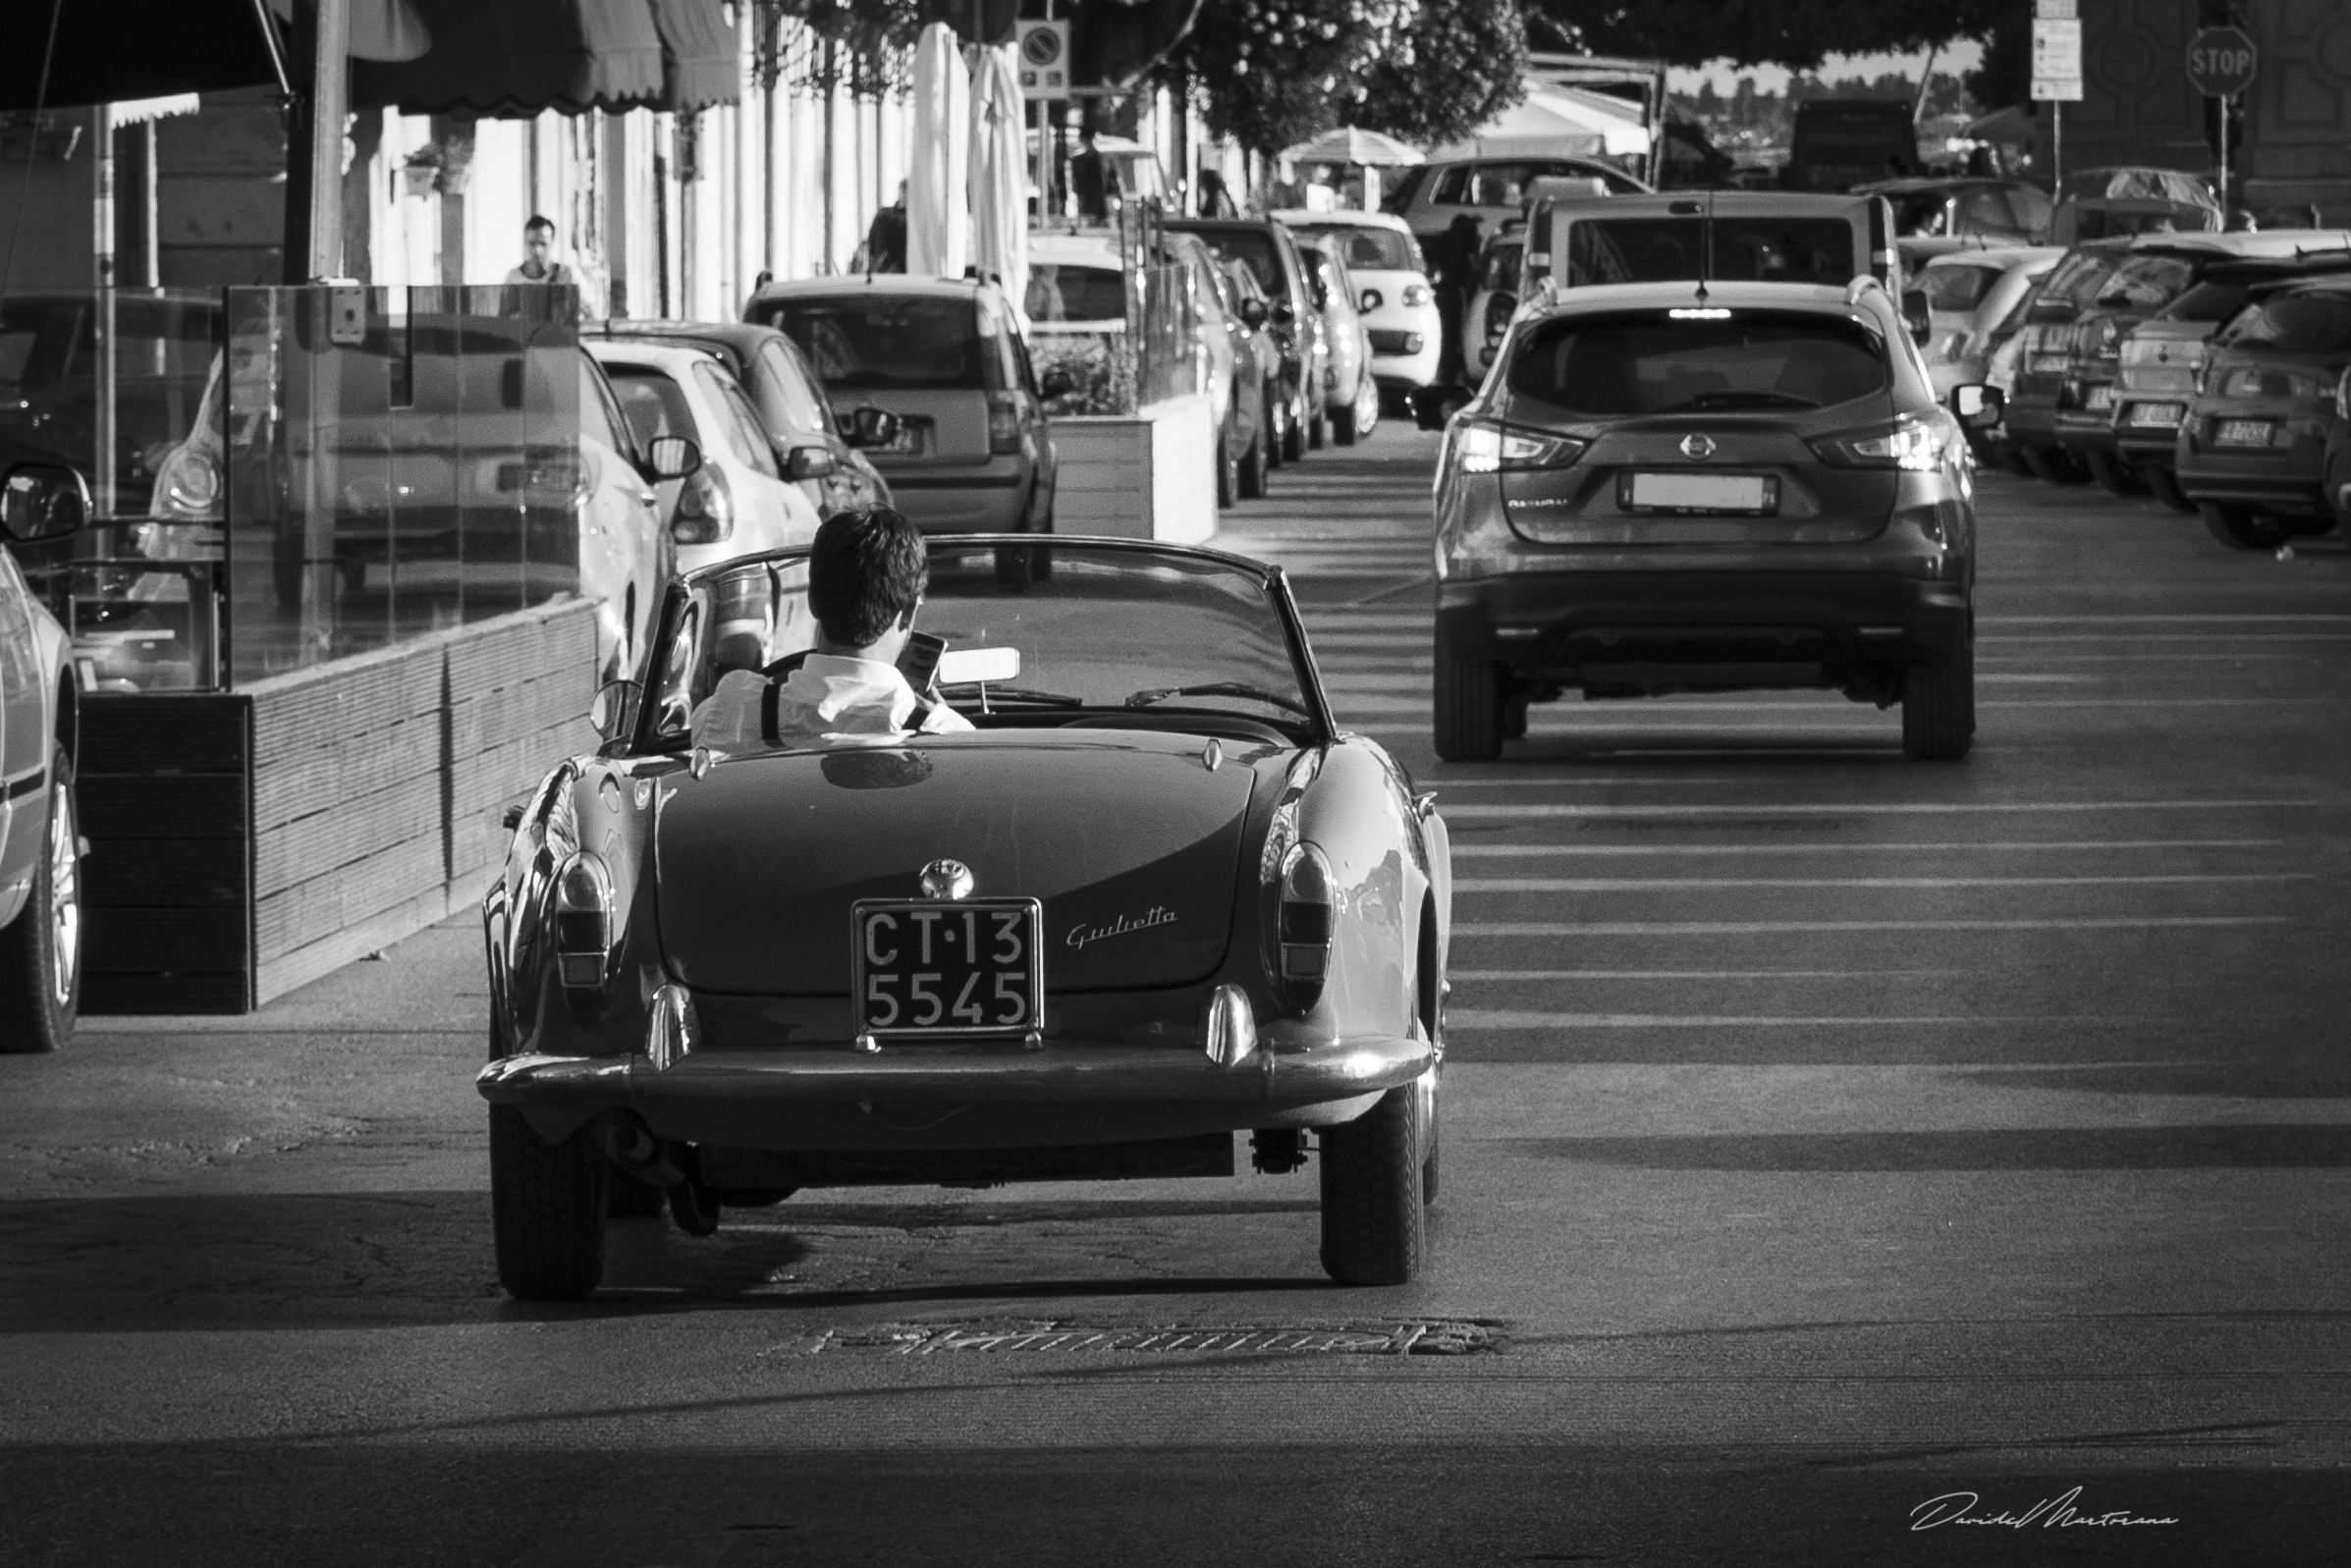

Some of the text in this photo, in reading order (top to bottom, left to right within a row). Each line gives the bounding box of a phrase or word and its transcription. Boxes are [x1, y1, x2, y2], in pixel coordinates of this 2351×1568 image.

[2192, 49, 2251, 76] STOP
[1066, 905, 1177, 949] Giulietta
[868, 972, 1025, 1026] 5545
